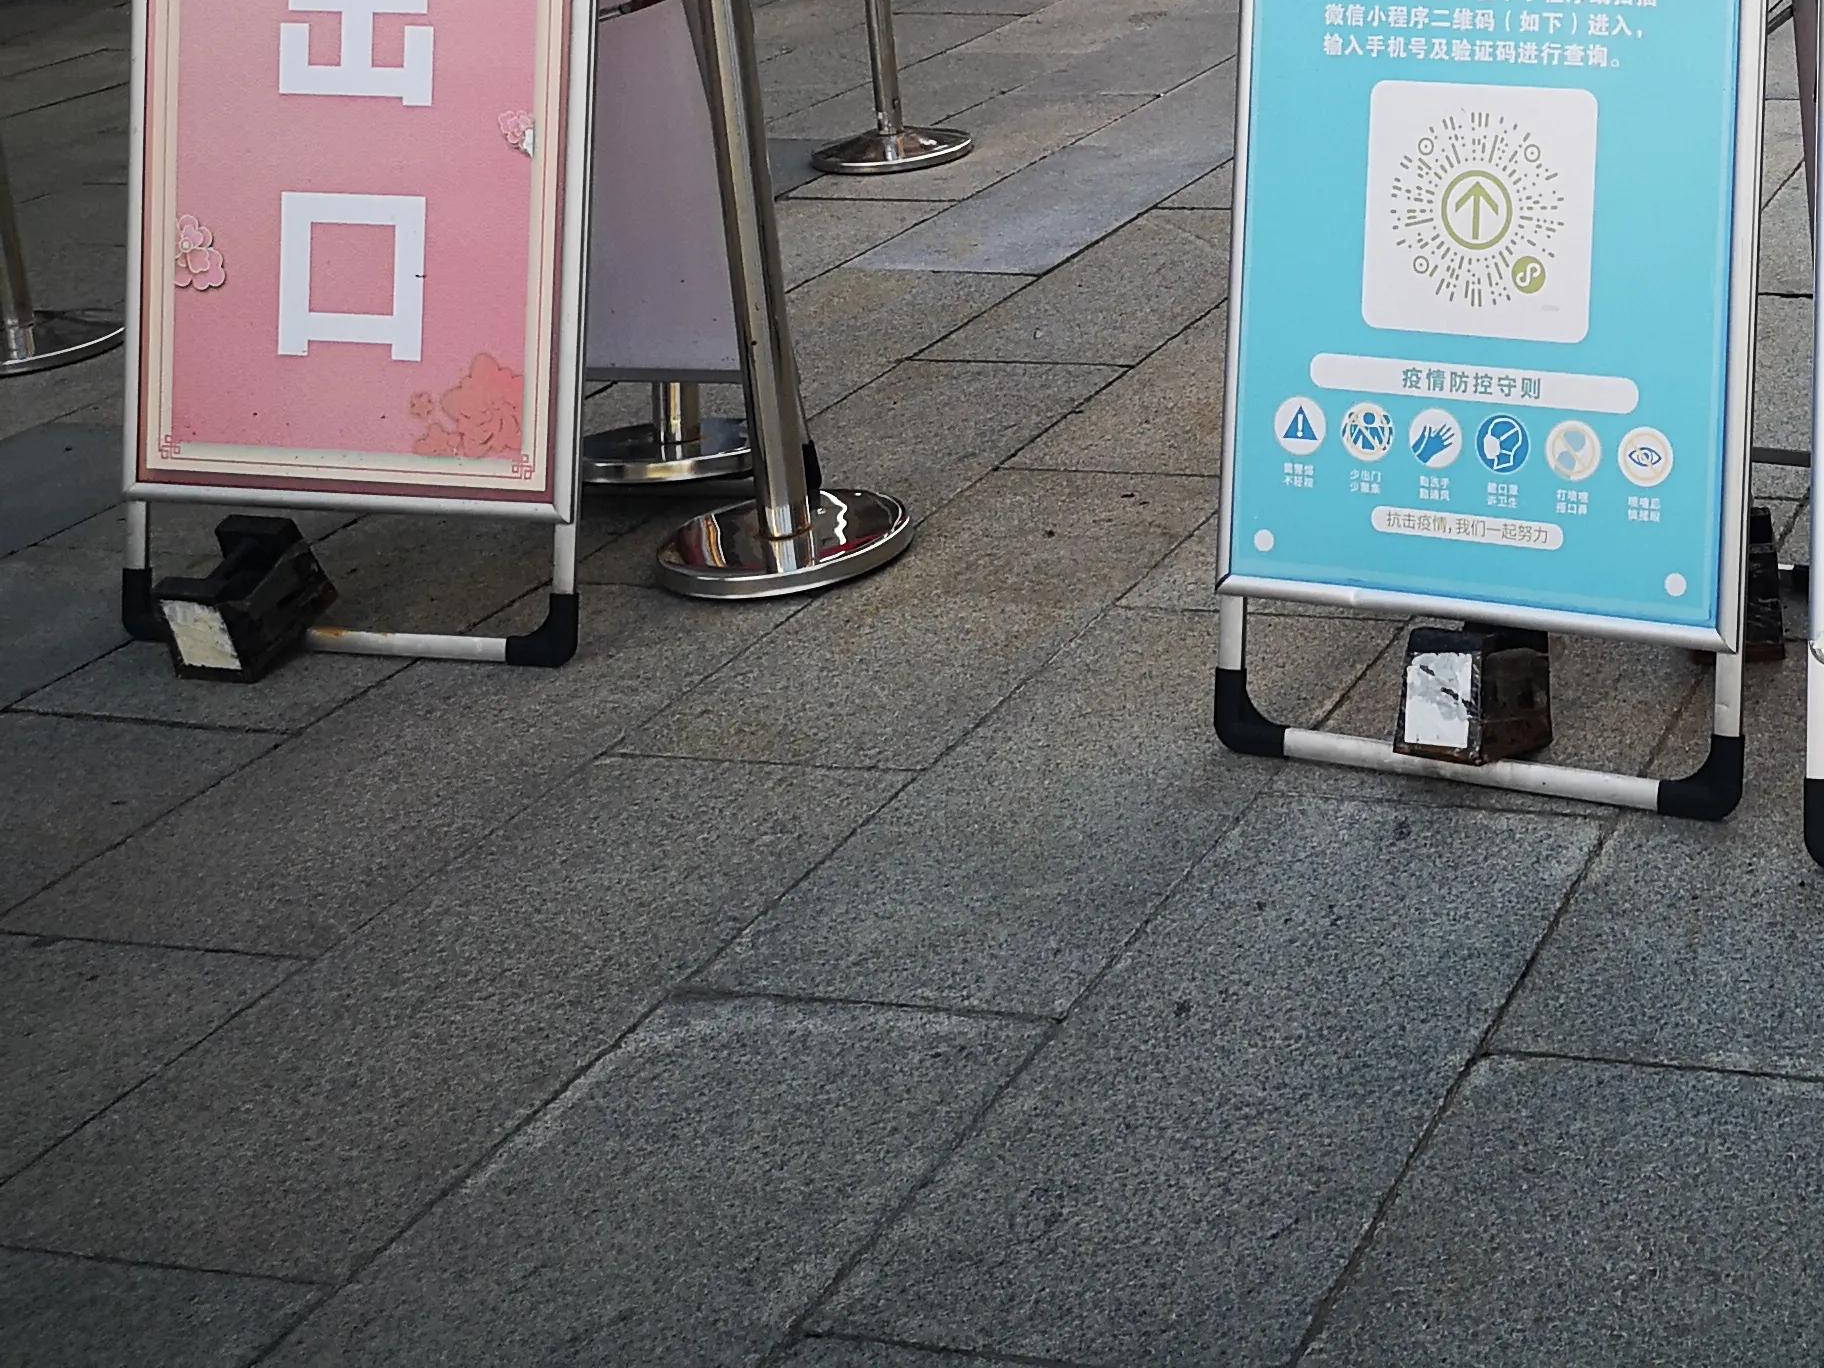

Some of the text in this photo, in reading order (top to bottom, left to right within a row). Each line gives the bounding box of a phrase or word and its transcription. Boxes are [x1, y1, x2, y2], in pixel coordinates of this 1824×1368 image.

[1324, 3, 1645, 38] 微信小程序二维码（如下）进入，
[1322, 33, 1622, 69] 输入手机号及验证码进行查询。
[1401, 367, 1542, 401] 疫情防控守则
